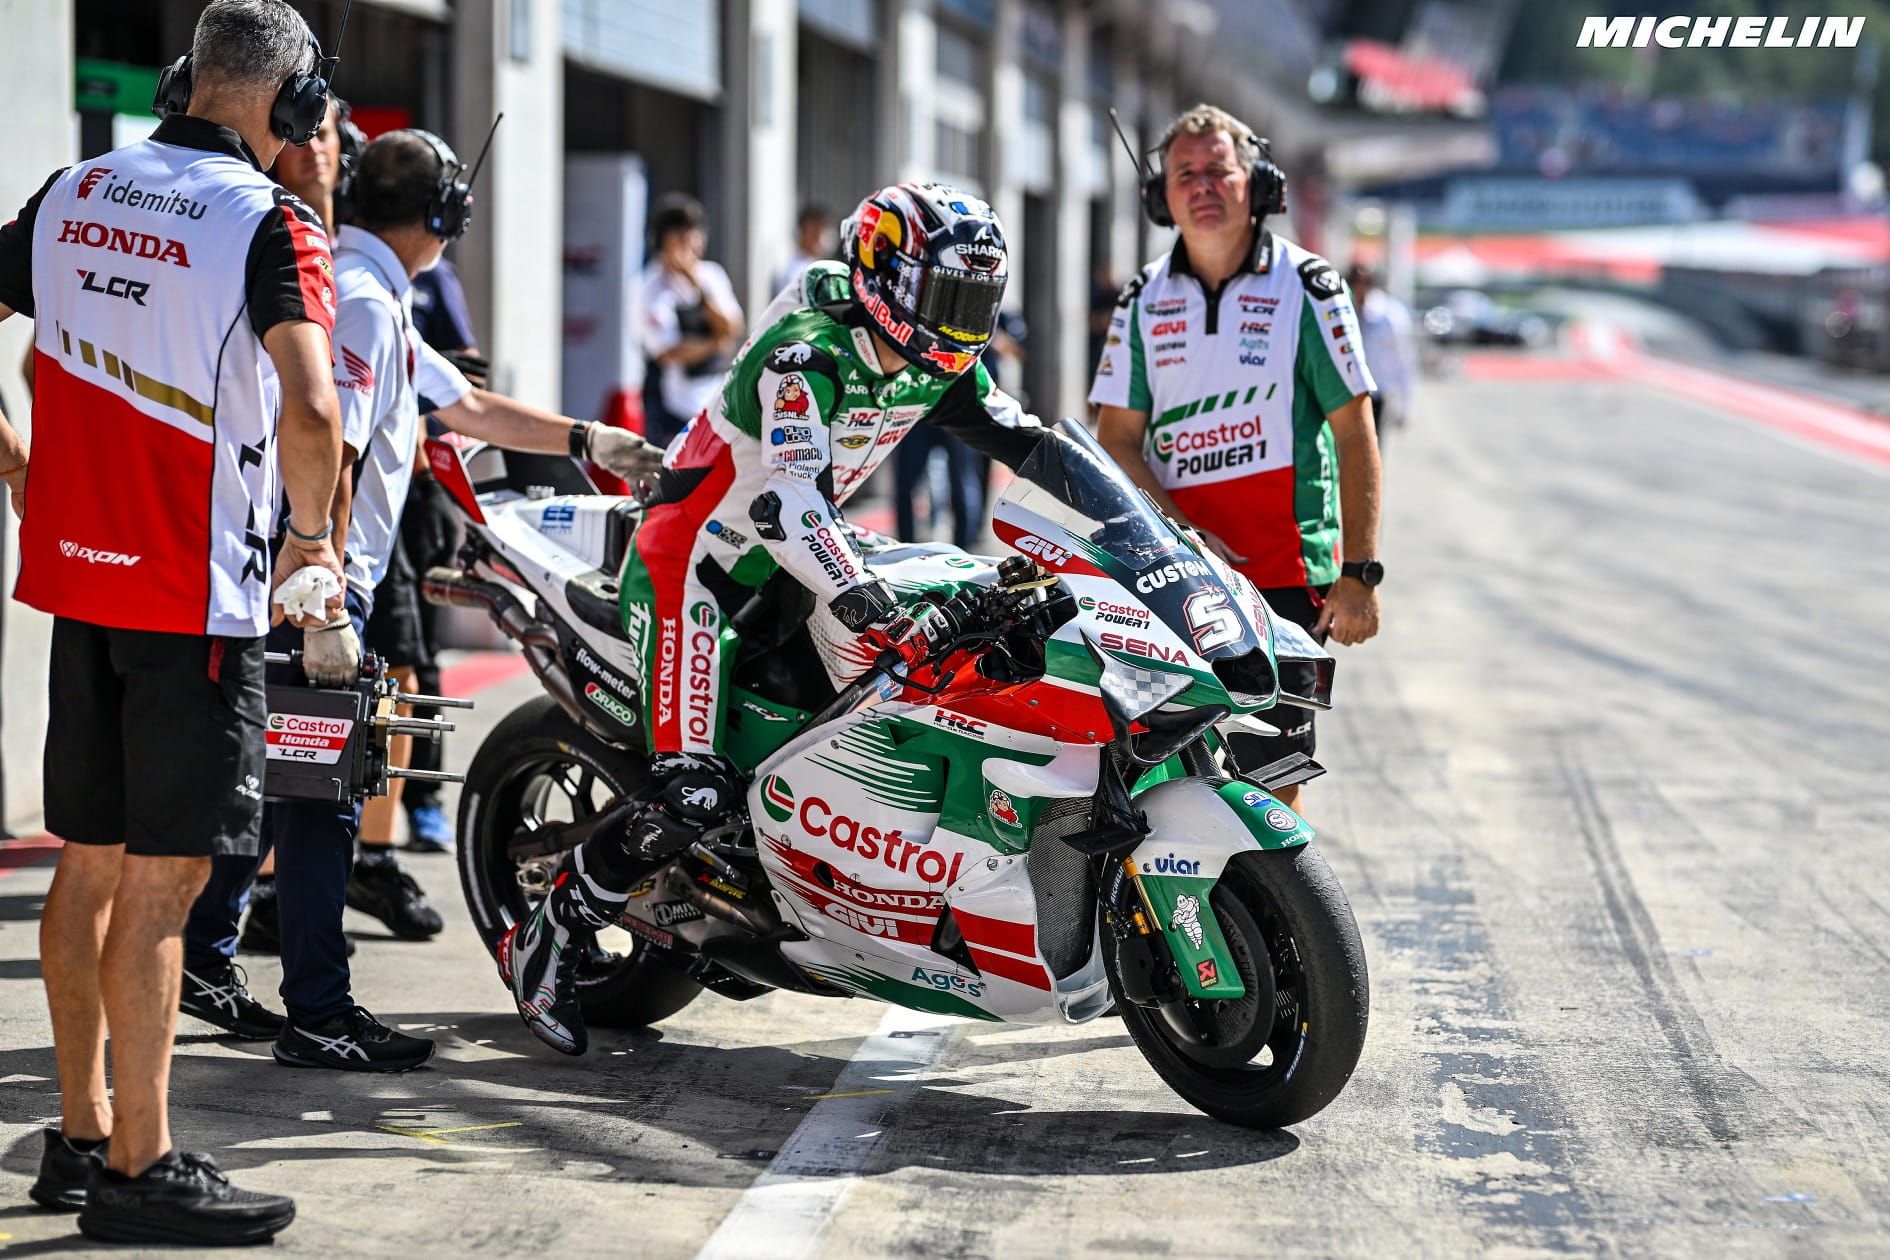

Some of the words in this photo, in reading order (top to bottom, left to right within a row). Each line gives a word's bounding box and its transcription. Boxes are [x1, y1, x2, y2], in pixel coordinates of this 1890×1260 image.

[103, 174, 208, 220] idemitsu
[57, 219, 191, 268] HONDA
[81, 269, 150, 306] LCR
[853, 267, 881, 316] Red
[873, 301, 915, 347] Bull
[1175, 415, 1263, 453] Castrol
[1176, 439, 1267, 479] POWER1
[801, 534, 849, 589] POWER1
[816, 528, 859, 580] Castrol
[1014, 535, 1069, 567] GIVI
[1136, 558, 1213, 594] CUSTOM
[1095, 611, 1151, 630] POWER1
[1097, 601, 1150, 620] Castrol
[1183, 584, 1246, 656] 5
[1100, 632, 1191, 667] SENA
[575, 648, 637, 700] flow-meter
[658, 617, 677, 728] HONDA
[688, 631, 719, 746] Castrol
[592, 687, 632, 723] DRACO
[934, 709, 988, 736] HRC
[279, 734, 330, 747] Honda
[286, 717, 345, 735] Castrol
[279, 748, 318, 761] LCR
[800, 796, 965, 888] Castrol
[1154, 852, 1201, 876] viar
[834, 878, 948, 911] HONDA
[825, 902, 899, 938] GIVI
[911, 966, 983, 998] Agos
